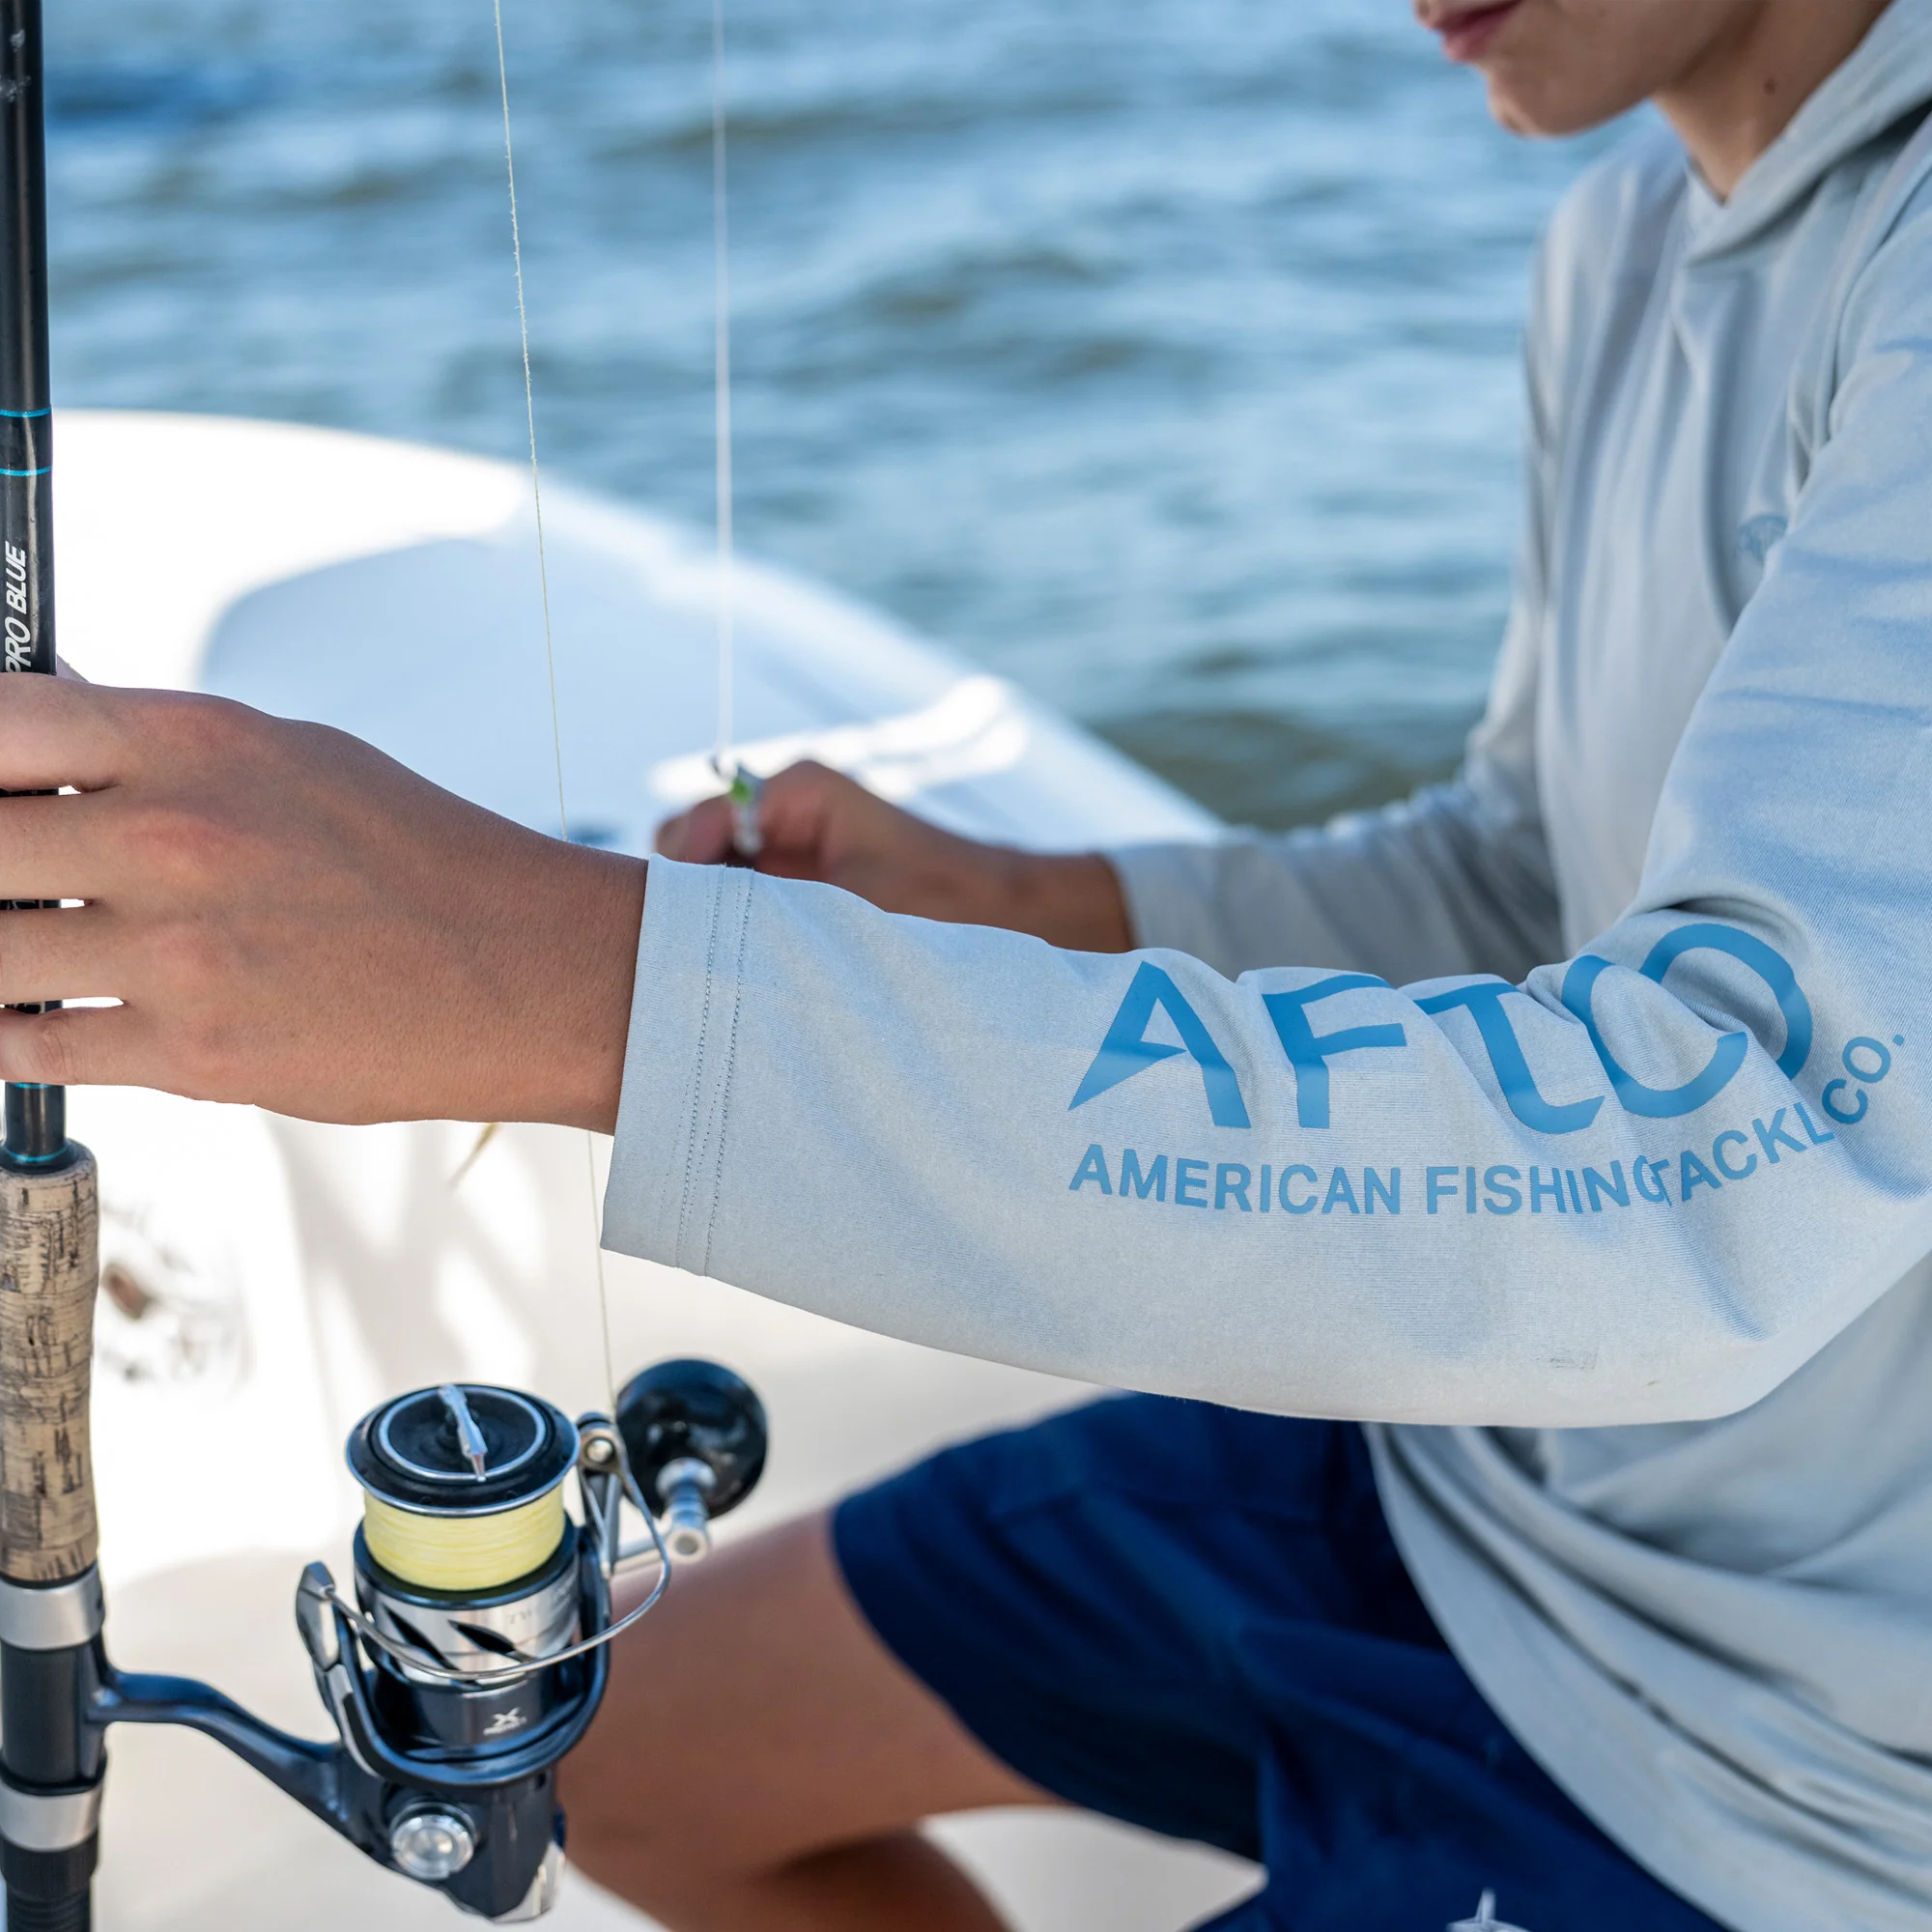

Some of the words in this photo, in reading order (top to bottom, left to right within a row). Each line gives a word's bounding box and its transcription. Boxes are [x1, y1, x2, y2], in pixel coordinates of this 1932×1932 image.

[5, 541, 27, 614] BLUE
[5, 616, 32, 673] PRO
[1070, 1144, 1401, 1215] AMERICAN
[1649, 1101, 1836, 1208] TACKL
[1821, 1035, 1906, 1125] CO.
